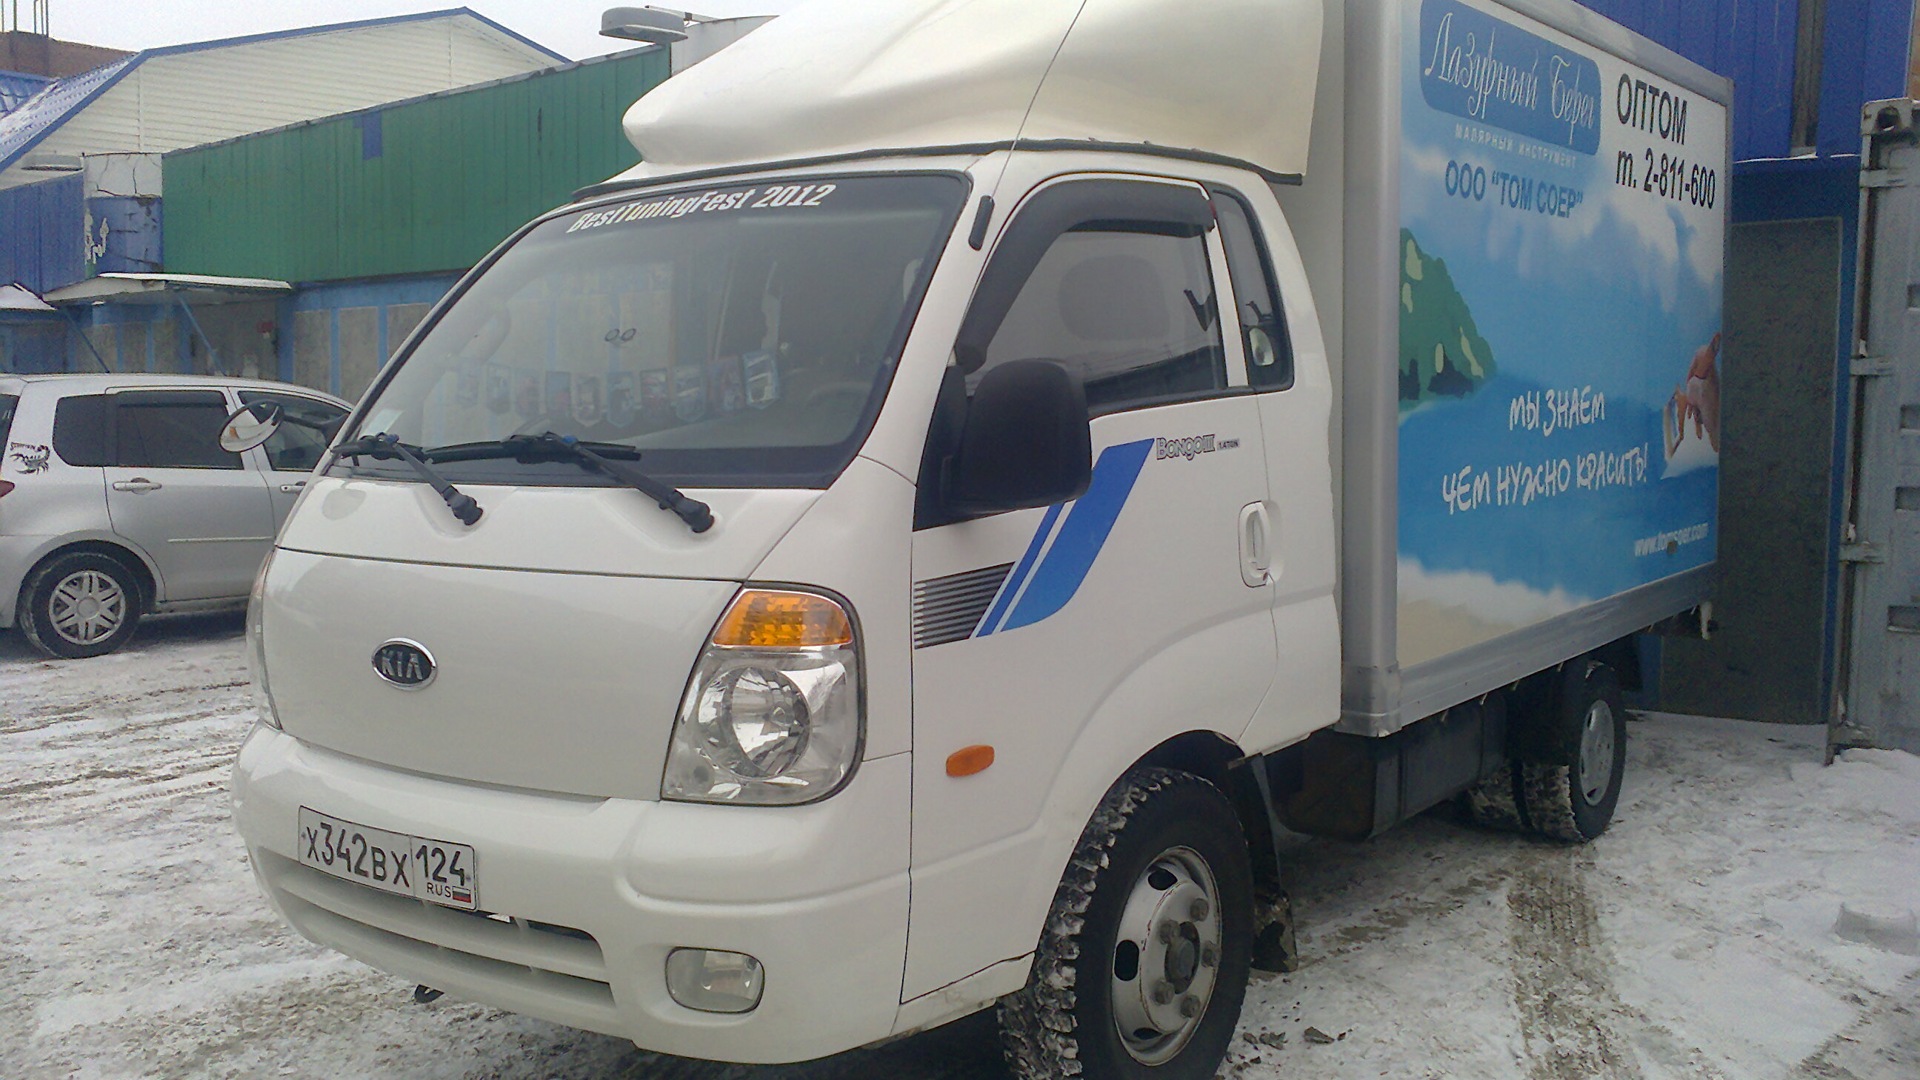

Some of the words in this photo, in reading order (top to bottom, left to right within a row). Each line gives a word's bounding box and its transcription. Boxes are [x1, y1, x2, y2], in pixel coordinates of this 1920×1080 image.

[1616, 73, 1688, 145] ОПТОМ
[1445, 160, 1486, 202] ООО
[1643, 147, 1716, 209] 2-811-600
[565, 188, 756, 234] BestTuningFest
[751, 184, 837, 208] 2012
[1442, 465, 1491, 515] ЧЕМ
[1497, 457, 1571, 506] НУЖНО
[381, 648, 423, 680] KIA
[415, 844, 466, 887] 124
[426, 881, 452, 898] RUS
